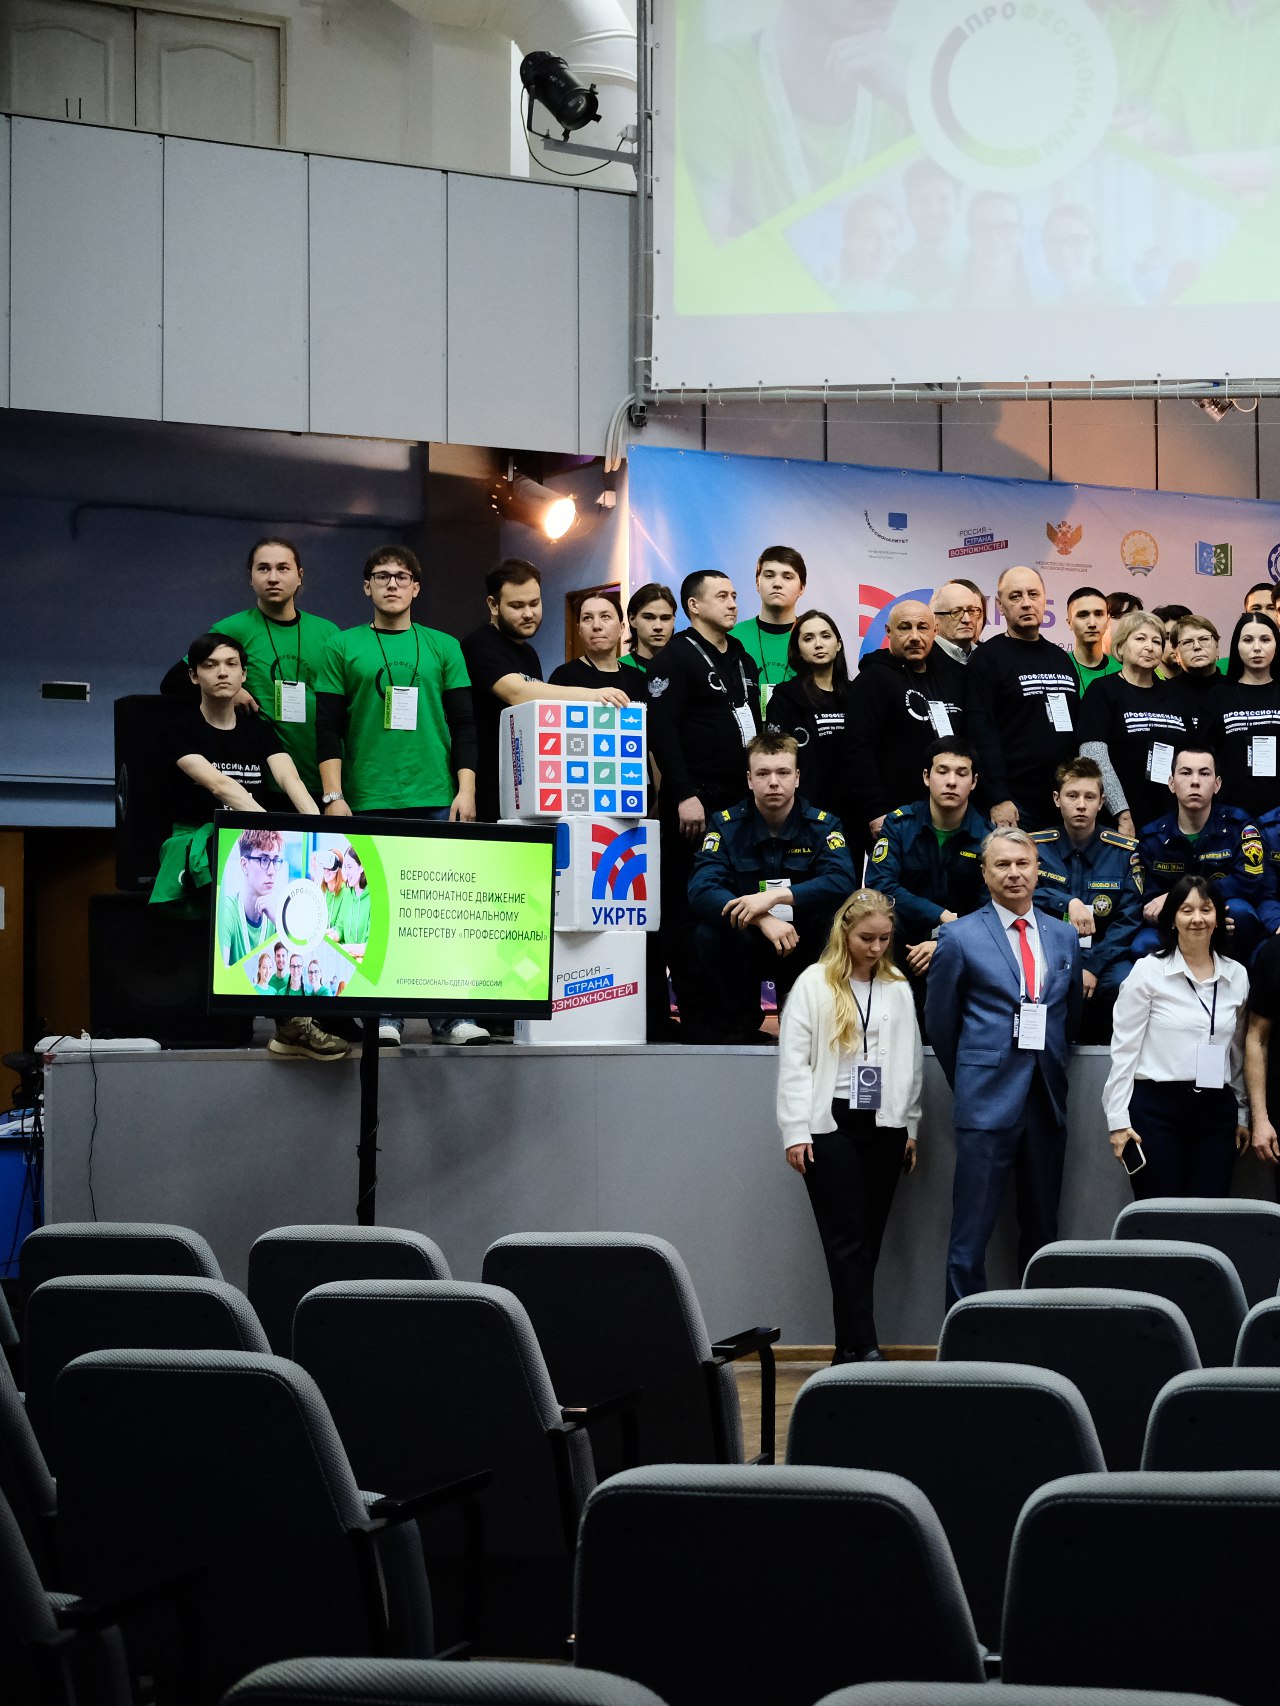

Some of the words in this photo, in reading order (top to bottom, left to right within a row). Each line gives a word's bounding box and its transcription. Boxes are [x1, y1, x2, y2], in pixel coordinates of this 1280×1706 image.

[960, 527, 987, 537] РОССИЯ
[965, 536, 992, 546] СТРАНА
[950, 541, 1006, 557] ВОЗМОЖНОСТЕЙ
[400, 869, 477, 883] ВСЕРОССИЙСКОЕ
[400, 889, 474, 901] ЧЕМПИОНАТНОЕ
[475, 892, 526, 904] ДВИЖЕНИЕ
[399, 908, 412, 919] ПО
[414, 908, 520, 922] ПРОФЕССИОНАЛЬНОМУ
[592, 906, 647, 926] УКРТБ
[398, 927, 457, 939] МАСТЕРСТВУ
[459, 928, 548, 941] «ПРОФЕССИОНАЛЫ»
[556, 966, 601, 983] РОССИЯ
[567, 978, 610, 995] СТРАНА
[551, 983, 634, 1012] ОЗМОЖНОСТЕЙ
